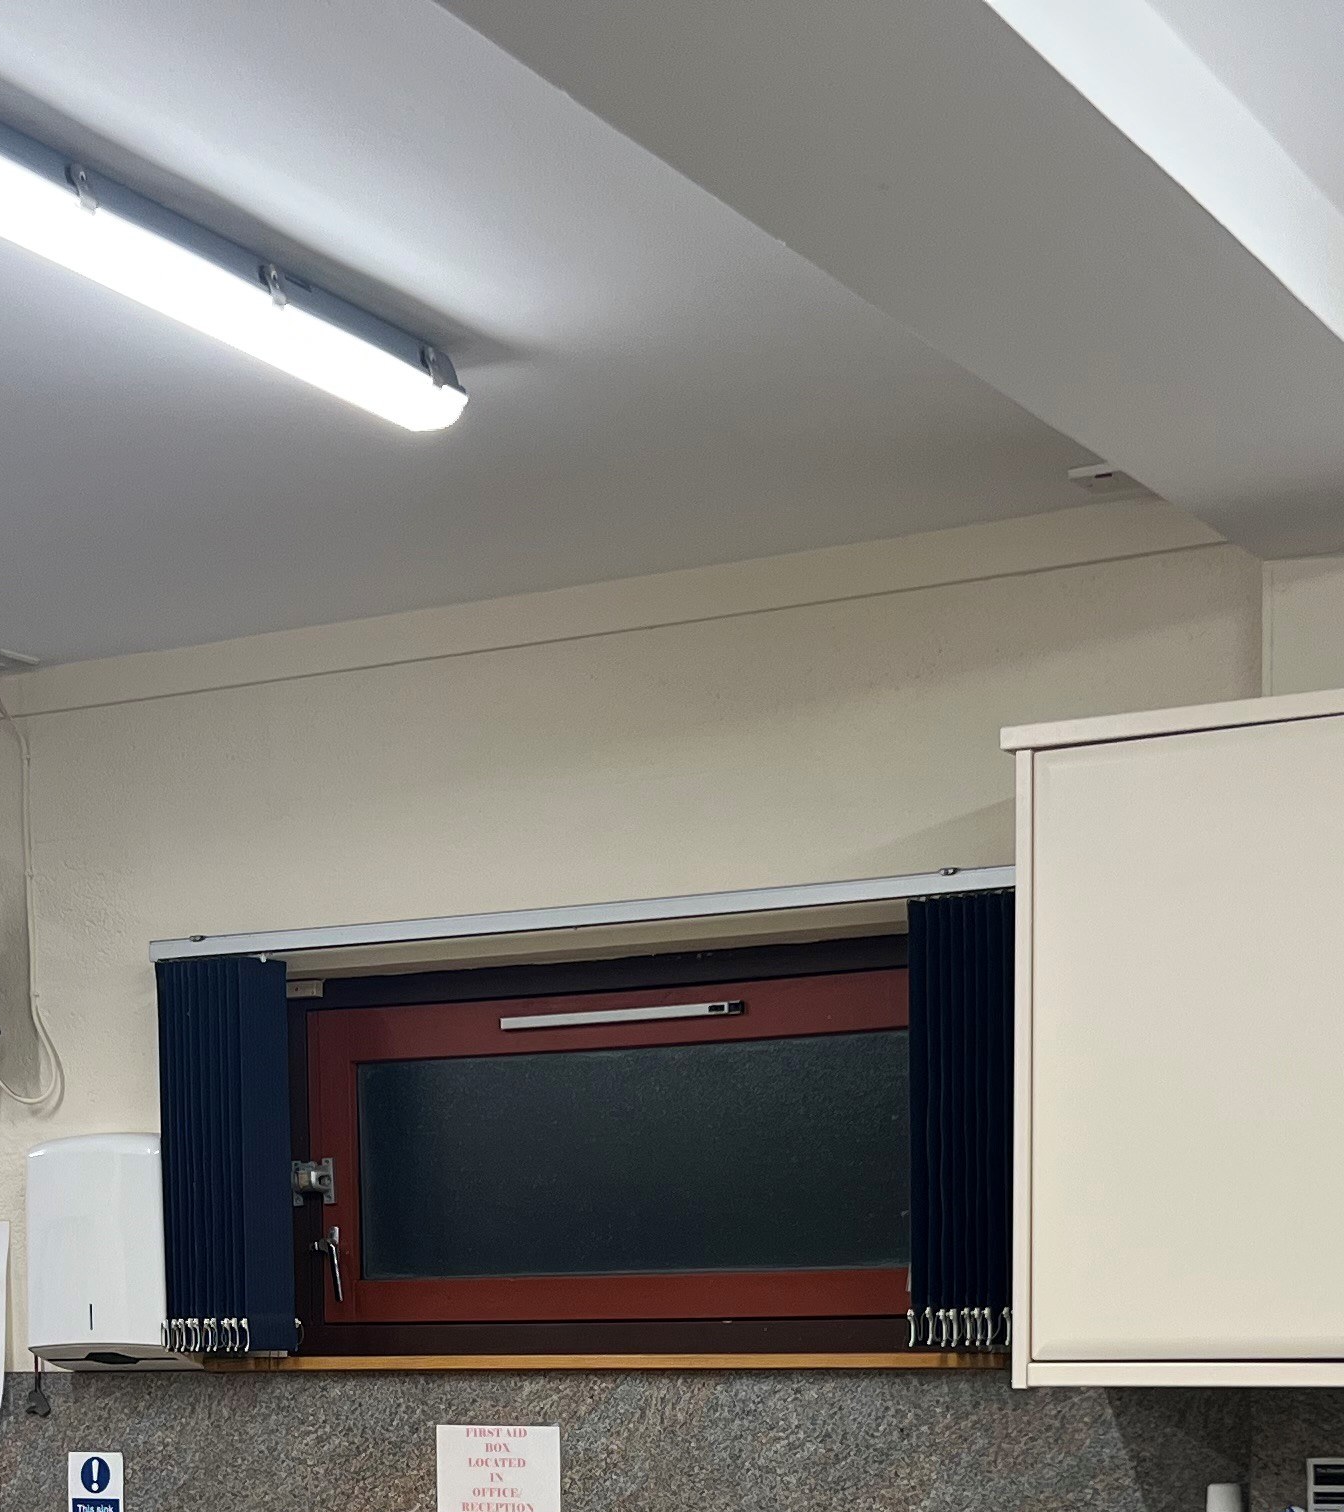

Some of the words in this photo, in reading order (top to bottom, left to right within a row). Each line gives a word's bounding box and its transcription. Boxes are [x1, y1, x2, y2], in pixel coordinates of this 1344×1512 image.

[466, 1427, 503, 1438] FIRST
[506, 1427, 528, 1438] AID
[485, 1442, 511, 1453] BOX
[468, 1457, 526, 1468] LOCATED
[489, 1472, 504, 1483] IN
[461, 1502, 534, 1512] RECEPTION
